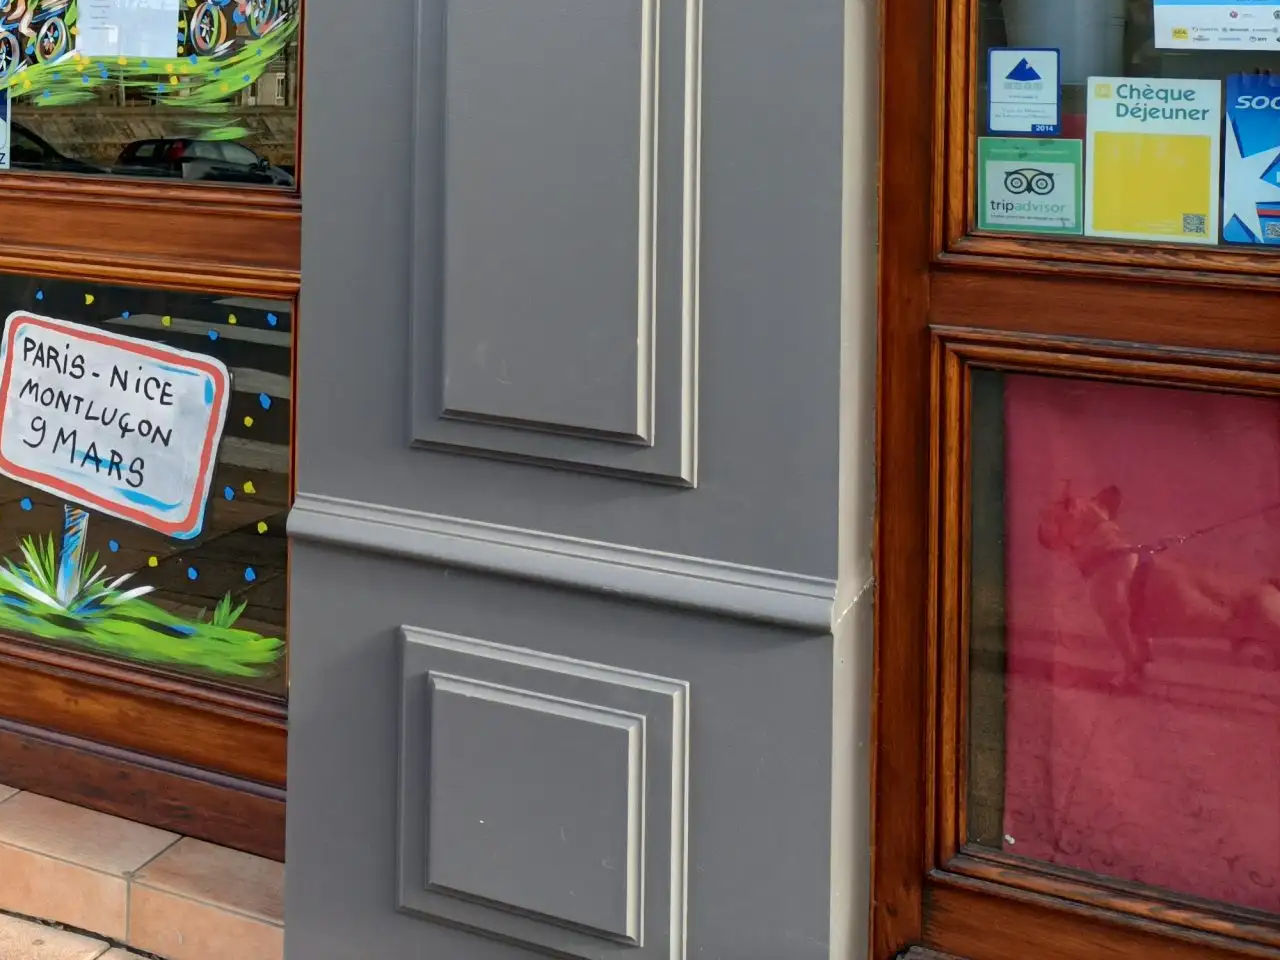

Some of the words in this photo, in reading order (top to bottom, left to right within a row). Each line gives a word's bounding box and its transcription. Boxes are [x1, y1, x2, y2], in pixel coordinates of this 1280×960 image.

[1115, 83, 1196, 103] Chèque
[1115, 102, 1210, 122] Déjeuner
[1035, 124, 1054, 133] 2014
[989, 198, 1068, 214] tripadvisor
[19, 378, 173, 448] MONTLUÇON
[22, 415, 47, 449] 9
[52, 427, 146, 489] MARS
